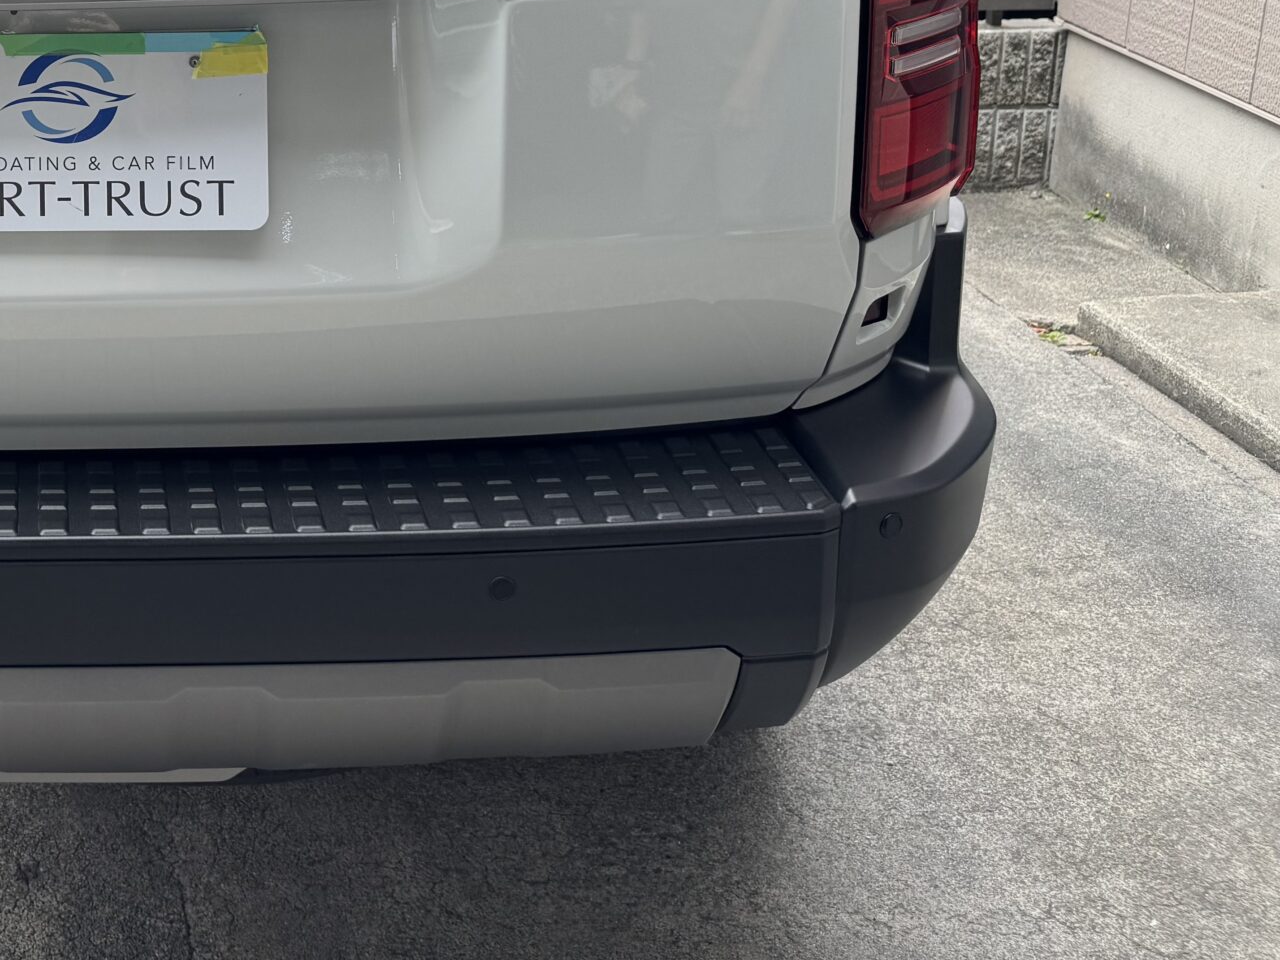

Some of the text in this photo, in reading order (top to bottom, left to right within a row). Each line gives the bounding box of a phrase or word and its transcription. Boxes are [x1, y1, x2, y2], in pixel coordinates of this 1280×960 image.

[88, 156, 101, 171] &
[111, 155, 156, 171] CAR
[166, 154, 216, 171] FILM
